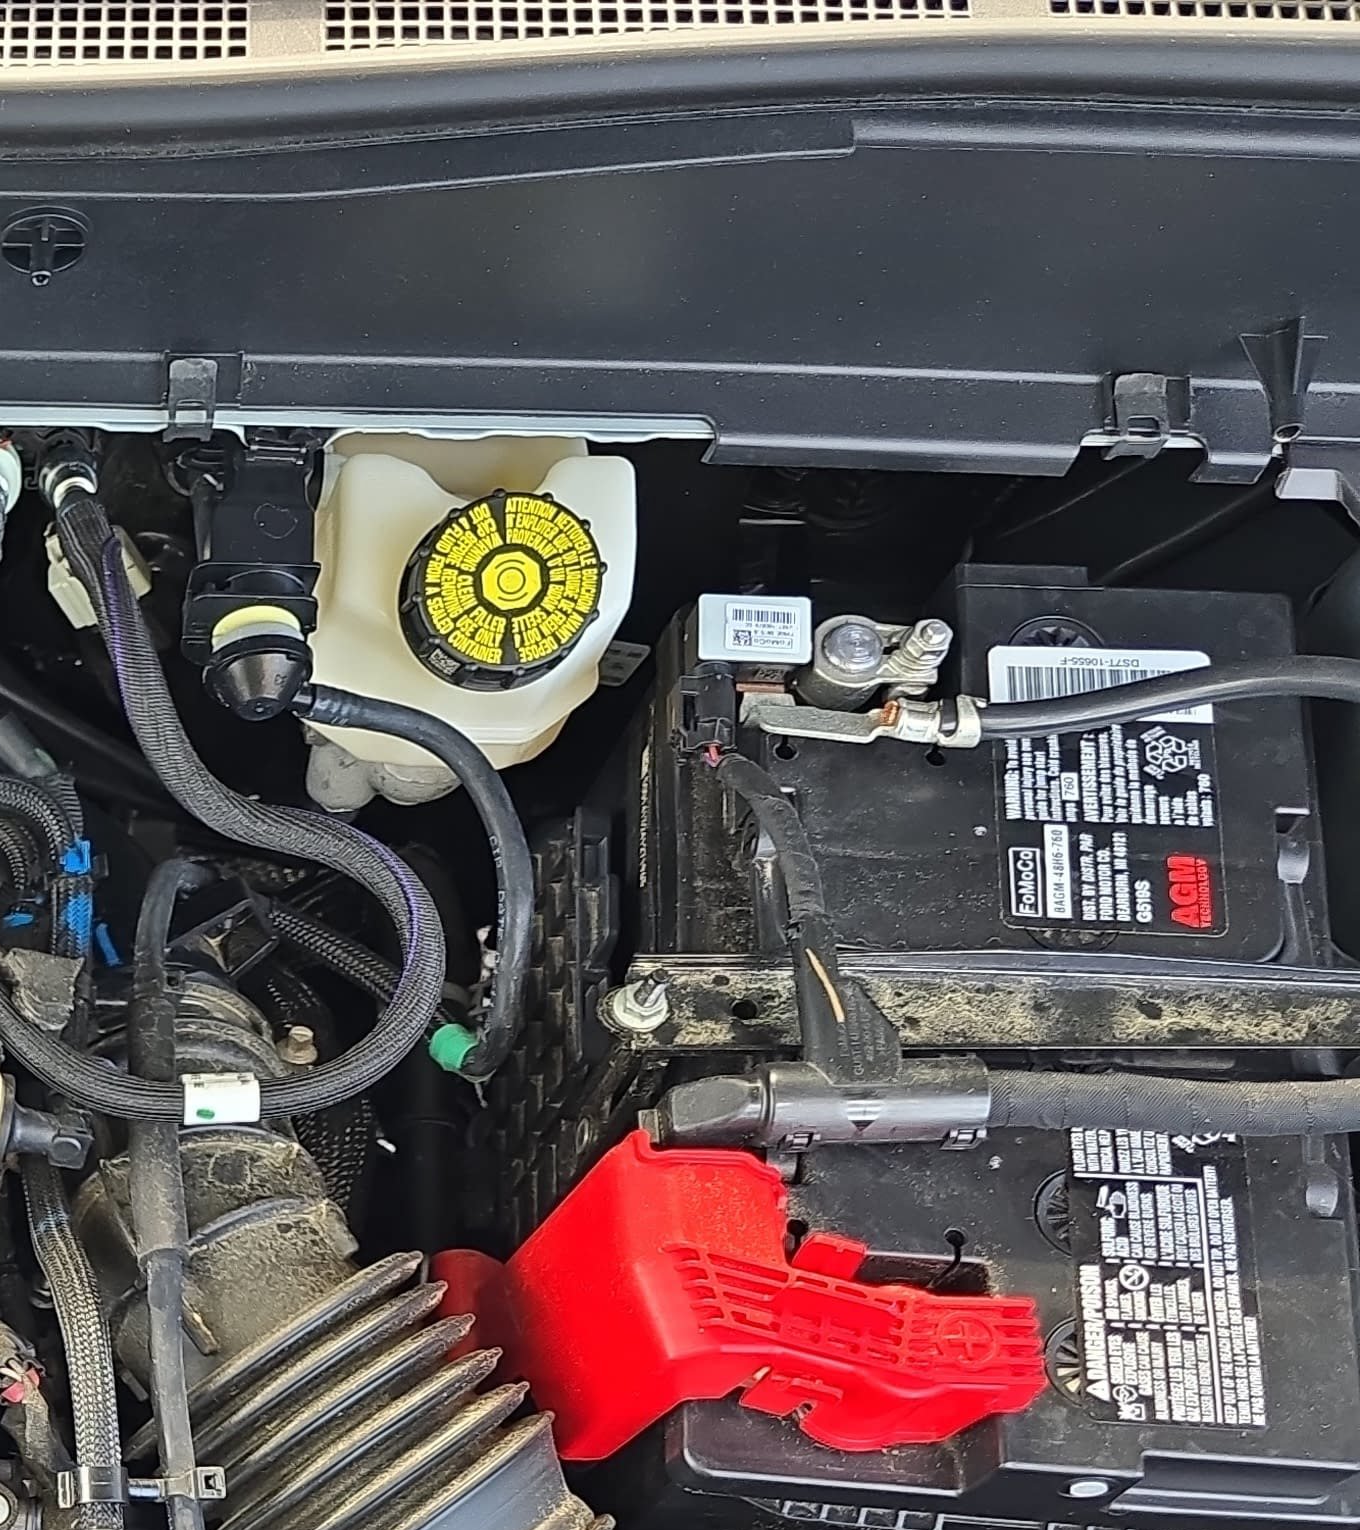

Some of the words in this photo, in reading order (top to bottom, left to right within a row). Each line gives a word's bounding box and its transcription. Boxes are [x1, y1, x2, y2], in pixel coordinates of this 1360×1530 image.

[469, 503, 491, 522] DOT
[505, 497, 558, 520] ATTENTION
[436, 523, 463, 553] FLUID
[477, 518, 496, 537] CAP
[446, 531, 477, 567] BEFORE
[462, 532, 504, 572] WARNING
[580, 553, 597, 567] LE
[426, 554, 445, 583] FROM
[575, 568, 598, 613] BOUCHON
[427, 597, 454, 634] SEALED
[456, 615, 475, 635] USE
[470, 606, 507, 632] FILLER
[555, 611, 585, 644] AVANT
[448, 630, 503, 664] CONTAINER
[1006, 760, 1019, 768] To
[1064, 777, 1075, 795] 760
[1080, 740, 1100, 821] AVERTISSEMENT
[1004, 770, 1022, 819] WARNING:
[1079, 832, 1093, 851] PAR
[1097, 846, 1110, 861] CO.
[1114, 858, 1128, 869] MI
[1016, 850, 1036, 913] FoMoCo
[1051, 829, 1066, 912] BAGM-48H6-760
[1098, 863, 1112, 894] MOTOR
[1082, 883, 1095, 895] BY
[1115, 870, 1131, 920] DEARBORN,
[1167, 855, 1198, 926] AGM
[1196, 858, 1212, 927] TECHNOLOGY
[1082, 898, 1097, 920] DIST.
[1099, 895, 1114, 920] FORD
[1207, 1199, 1220, 1218] OPEN
[1209, 1219, 1221, 1233] NOT
[1115, 1236, 1129, 1257] ACID
[1211, 1235, 1221, 1245] DO
[1213, 1261, 1225, 1275] NOT
[1214, 1276, 1225, 1288] DO
[1079, 1264, 1108, 1379] DANGER/POISON
[1107, 1333, 1122, 1355] EYES
[1218, 1339, 1232, 1362] REACH
[1221, 1363, 1233, 1376] THE
[1222, 1377, 1234, 1387] OF
[1224, 1389, 1236, 1404] OUT
[1224, 1405, 1237, 1423] KEEP
